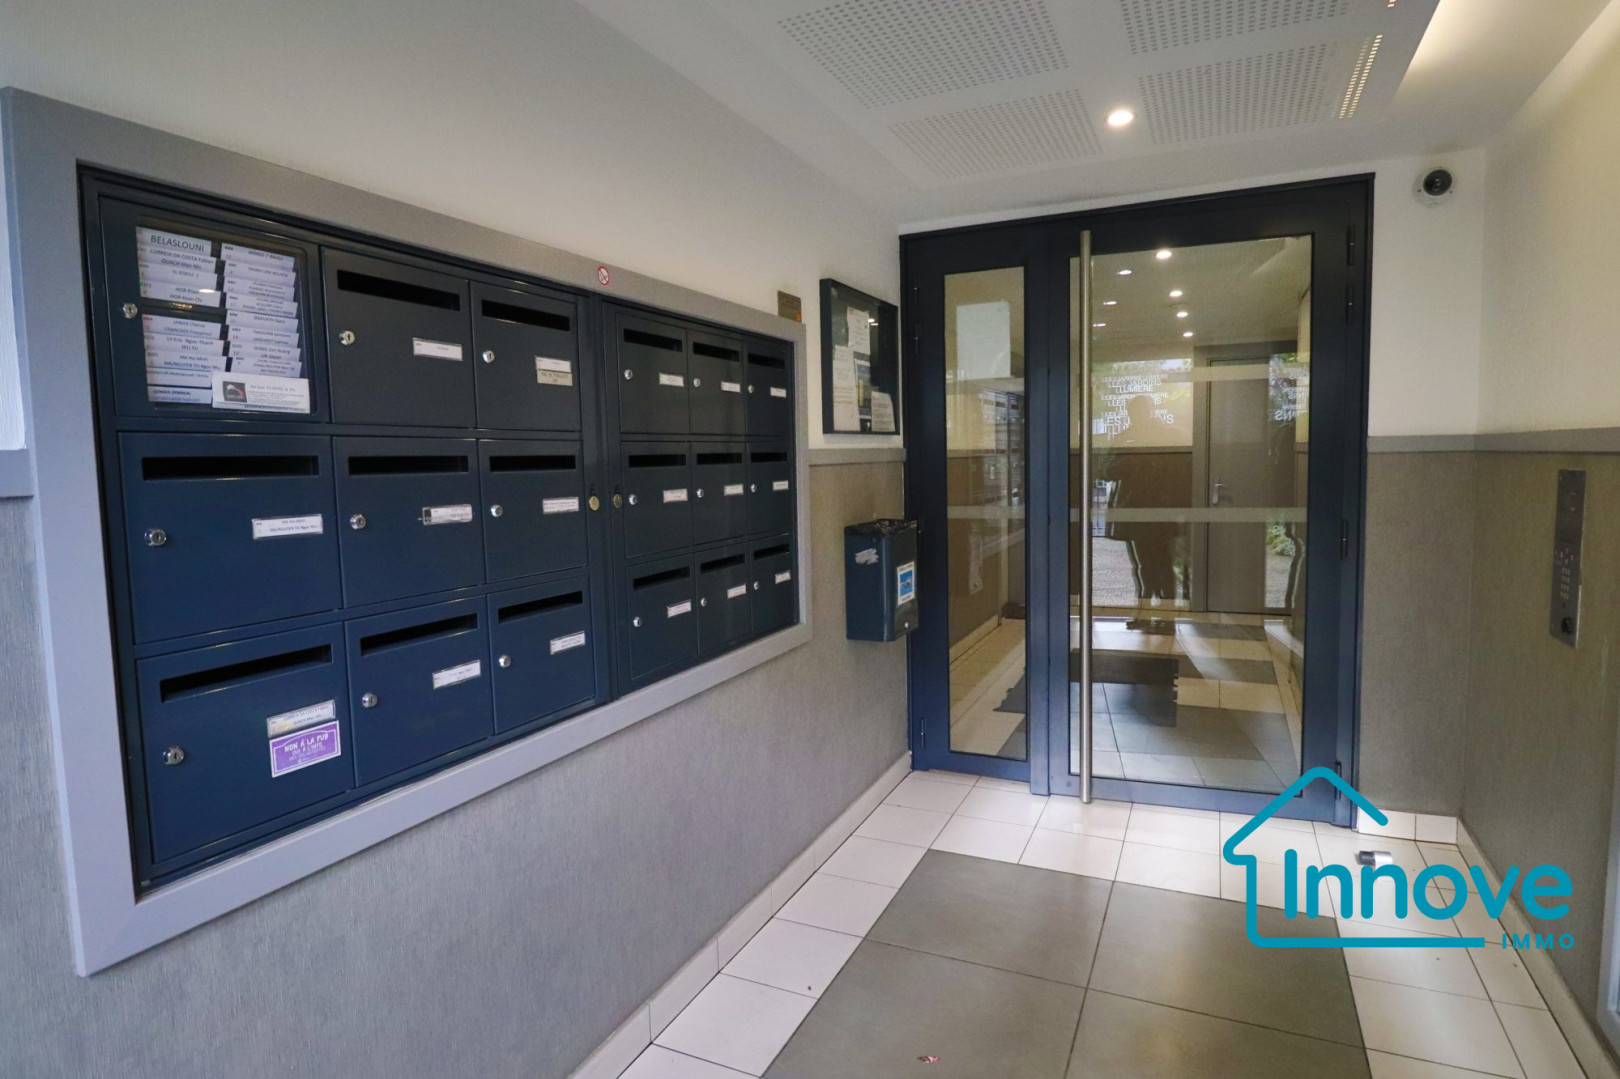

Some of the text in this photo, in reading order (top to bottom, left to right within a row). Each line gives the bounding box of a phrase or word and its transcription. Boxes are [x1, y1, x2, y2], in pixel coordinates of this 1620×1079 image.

[150, 234, 205, 253] BELASLOUNI
[284, 742, 299, 753] NON
[307, 737, 315, 746] LA
